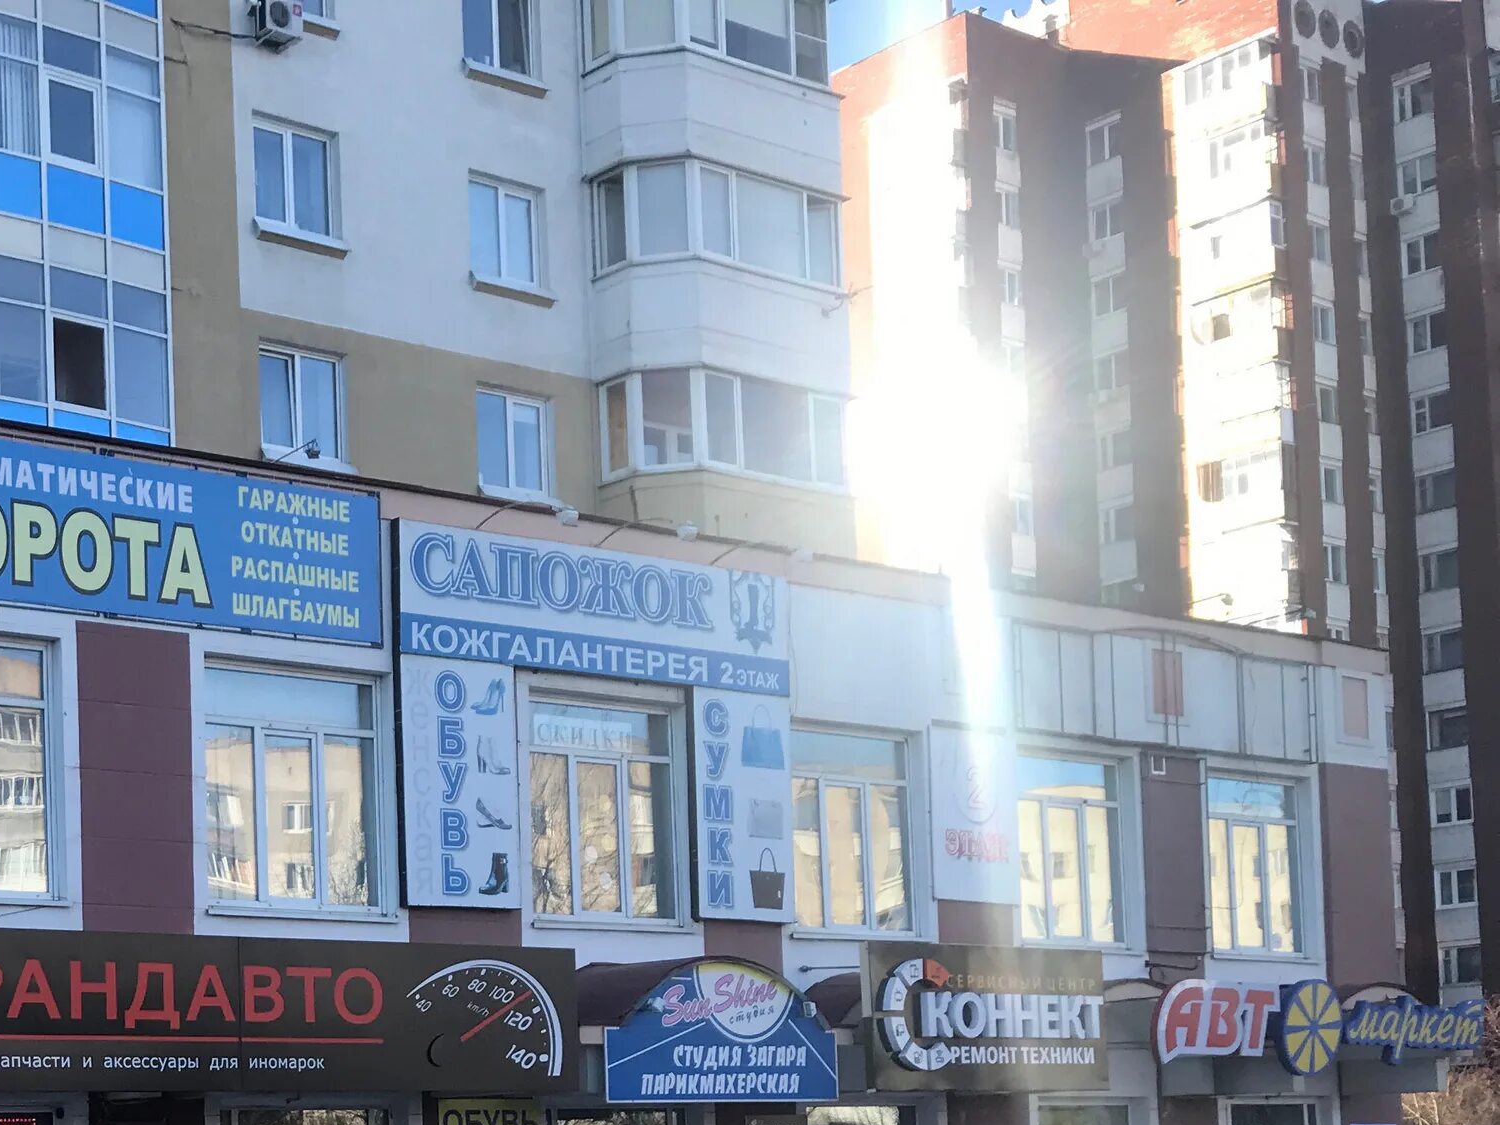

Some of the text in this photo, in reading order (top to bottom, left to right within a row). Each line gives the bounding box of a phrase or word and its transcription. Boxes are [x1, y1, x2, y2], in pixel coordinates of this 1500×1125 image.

[237, 485, 350, 524] ГАРАЖНЫЕ
[240, 520, 349, 557] ОТКАТНЫЕ
[231, 555, 360, 593] РАСПАШНЫЕ
[409, 531, 714, 632] САПОЖОК
[231, 591, 361, 629] ШЛАГБАУМЫ
[411, 621, 780, 690] КОЖГАЛАНТЕРЕЯ 2 ЭТАЖ
[433, 669, 471, 898] ОБУВЬ
[702, 698, 735, 911] СУМКИ
[442, 984, 460, 998] 60
[467, 979, 488, 993] 80
[488, 985, 516, 1004] 100
[947, 973, 1097, 992] СЕРВИСНЫЙ ЦЕНТР
[415, 999, 432, 1012] 40
[466, 1001, 490, 1017] km/h
[662, 973, 778, 1028] Sun Shine
[503, 1010, 533, 1031] 120
[729, 1005, 775, 1025] студия
[920, 990, 1104, 1039] КОННЕКТ
[1350, 1003, 1482, 1060] маркет
[82, 1056, 93, 1069] и
[103, 1055, 200, 1073] аксессуары
[210, 1055, 239, 1072] для
[248, 1056, 325, 1074] иномарок
[505, 1044, 537, 1070] 140
[673, 1044, 807, 1071] СТУДИЯ ЗАГАРА
[950, 1045, 1095, 1065] РЕМОНТ ТЕХНИКИ
[640, 1071, 800, 1096] ПАРИКМАХЕРСКАЯ
